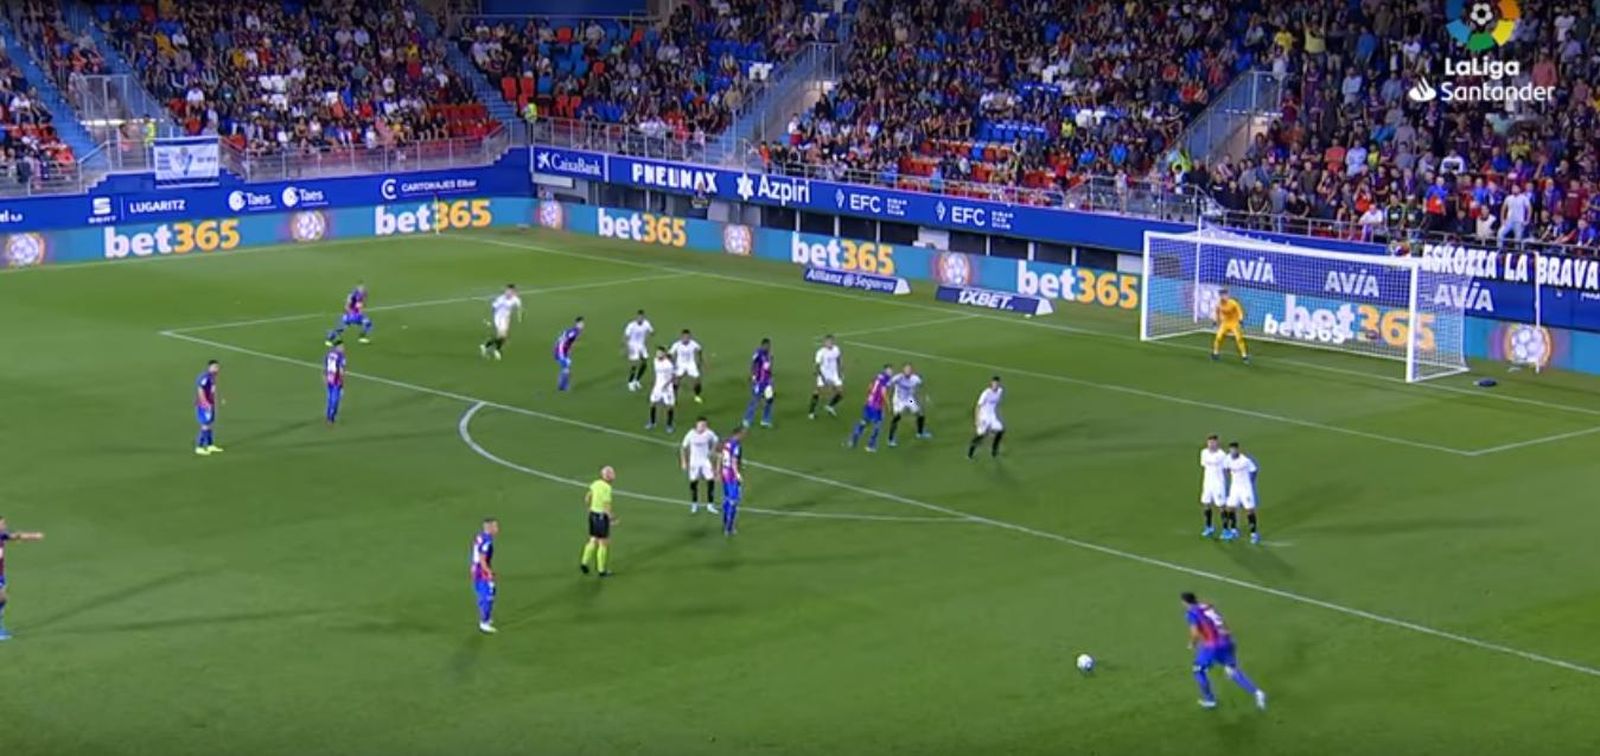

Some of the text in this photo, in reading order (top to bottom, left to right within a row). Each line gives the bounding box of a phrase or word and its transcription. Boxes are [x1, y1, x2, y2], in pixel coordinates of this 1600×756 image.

[551, 153, 602, 176] CaixaBank
[246, 192, 272, 206] Taes
[299, 188, 324, 202] Taes
[758, 174, 810, 206] Azpiri
[850, 193, 881, 213] EFC
[129, 200, 186, 213] LUGARITZ
[374, 199, 493, 236] bet365
[951, 206, 985, 226] EFC
[104, 219, 241, 258] bet365
[597, 207, 687, 247] bet365
[791, 231, 895, 276] bet365
[806, 268, 895, 291] Allianz Seguros
[1017, 259, 1139, 309] bet365
[1504, 252, 1528, 282] LA
[1536, 255, 1599, 291] BRAVA
[1285, 294, 1436, 351] bet365
